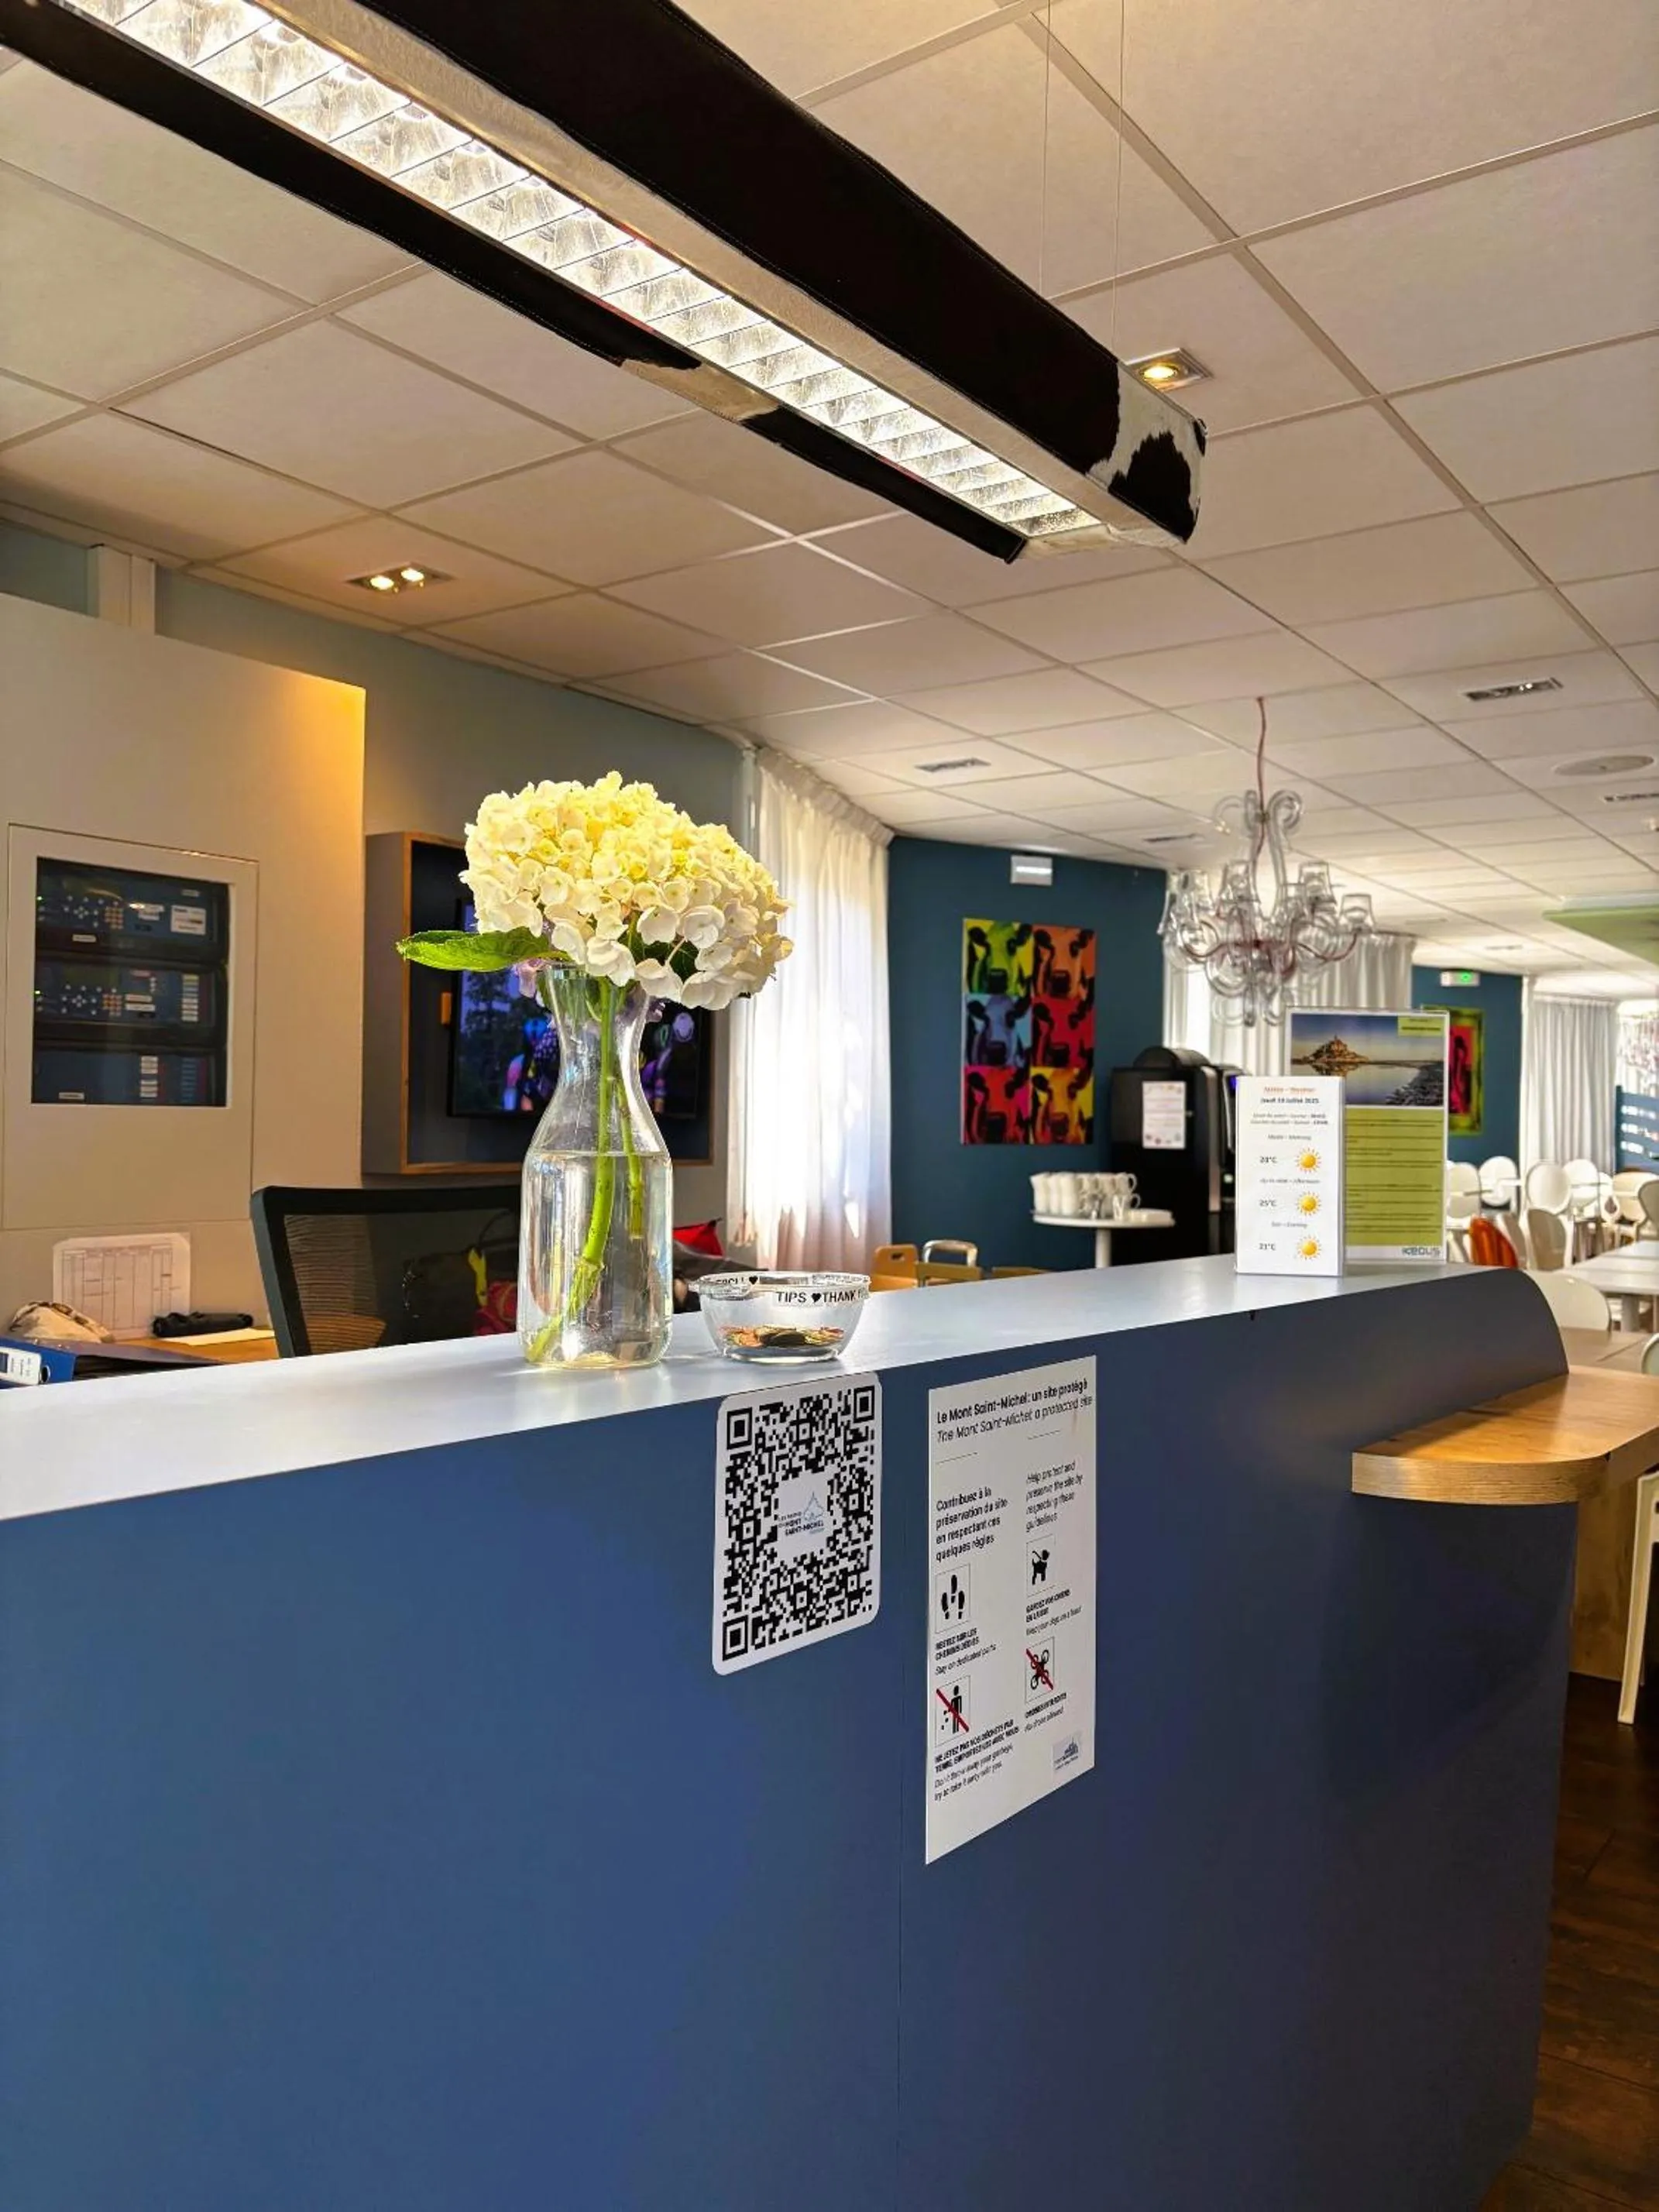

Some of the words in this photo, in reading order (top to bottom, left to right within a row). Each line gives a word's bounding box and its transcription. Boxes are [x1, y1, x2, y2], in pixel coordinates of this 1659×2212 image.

[776, 1291, 807, 1304] TIPS
[823, 1289, 856, 1303] THANK
[937, 1412, 947, 1424] Le
[950, 1406, 972, 1421] Mont
[1032, 1392, 1042, 1401] un
[1044, 1386, 1057, 1399] site
[1059, 1378, 1087, 1399] protégé
[938, 1430, 953, 1442] The
[957, 1423, 978, 1437] Mont
[1035, 1409, 1040, 1419] a
[1042, 1398, 1078, 1420] protected
[1080, 1396, 1092, 1407] site
[936, 1492, 977, 1512] Contribuez
[984, 1486, 991, 1497] la
[785, 1520, 824, 1536] SAINT-MICHEL
[936, 1506, 983, 1531] préservation
[984, 1503, 993, 1513] du
[995, 1498, 1008, 1510] site
[936, 1534, 946, 1544] en
[948, 1520, 987, 1541] respectant
[988, 1517, 1000, 1527] ces
[936, 1542, 970, 1563] quelques
[972, 1534, 994, 1549] règles
